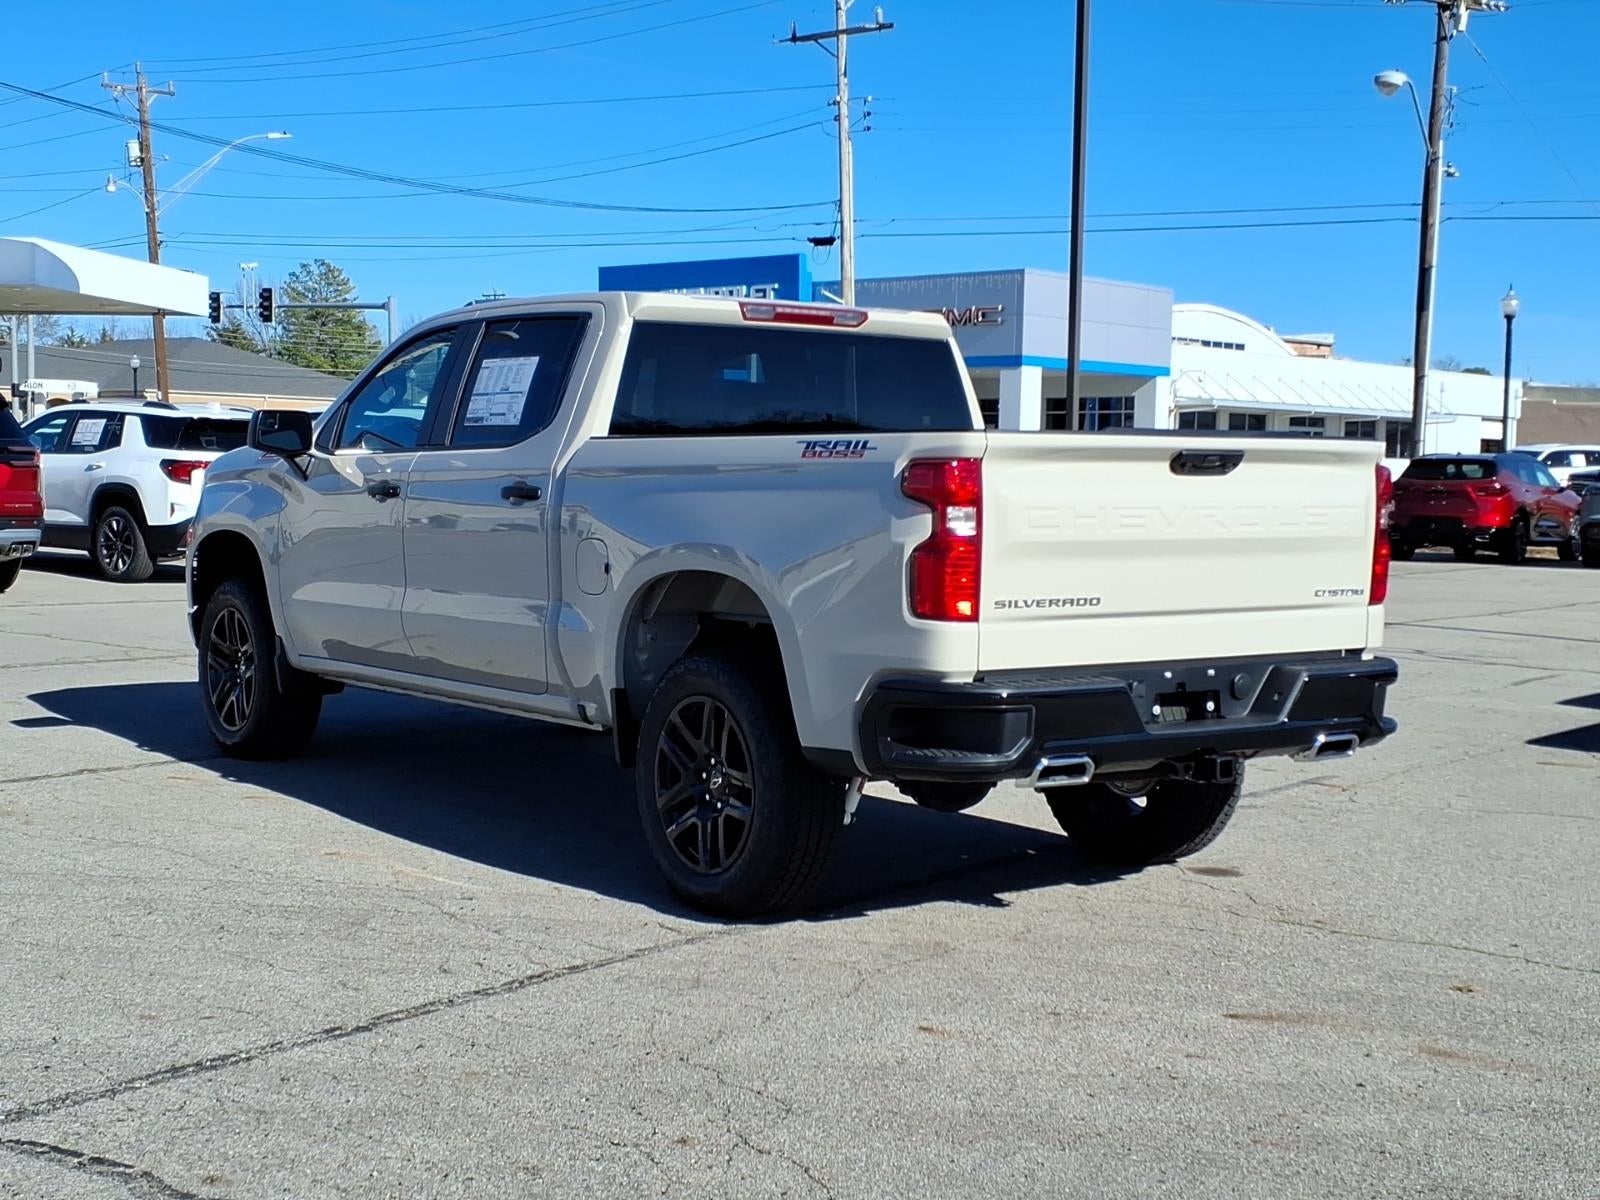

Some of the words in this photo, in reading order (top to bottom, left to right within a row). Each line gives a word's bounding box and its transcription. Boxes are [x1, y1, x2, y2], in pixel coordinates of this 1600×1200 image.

[921, 304, 1003, 327] MC
[797, 440, 877, 450] TRAIL
[801, 450, 866, 458] BOSS
[1023, 505, 1358, 534] CHEVROLET
[994, 597, 1101, 609] SILVERADO
